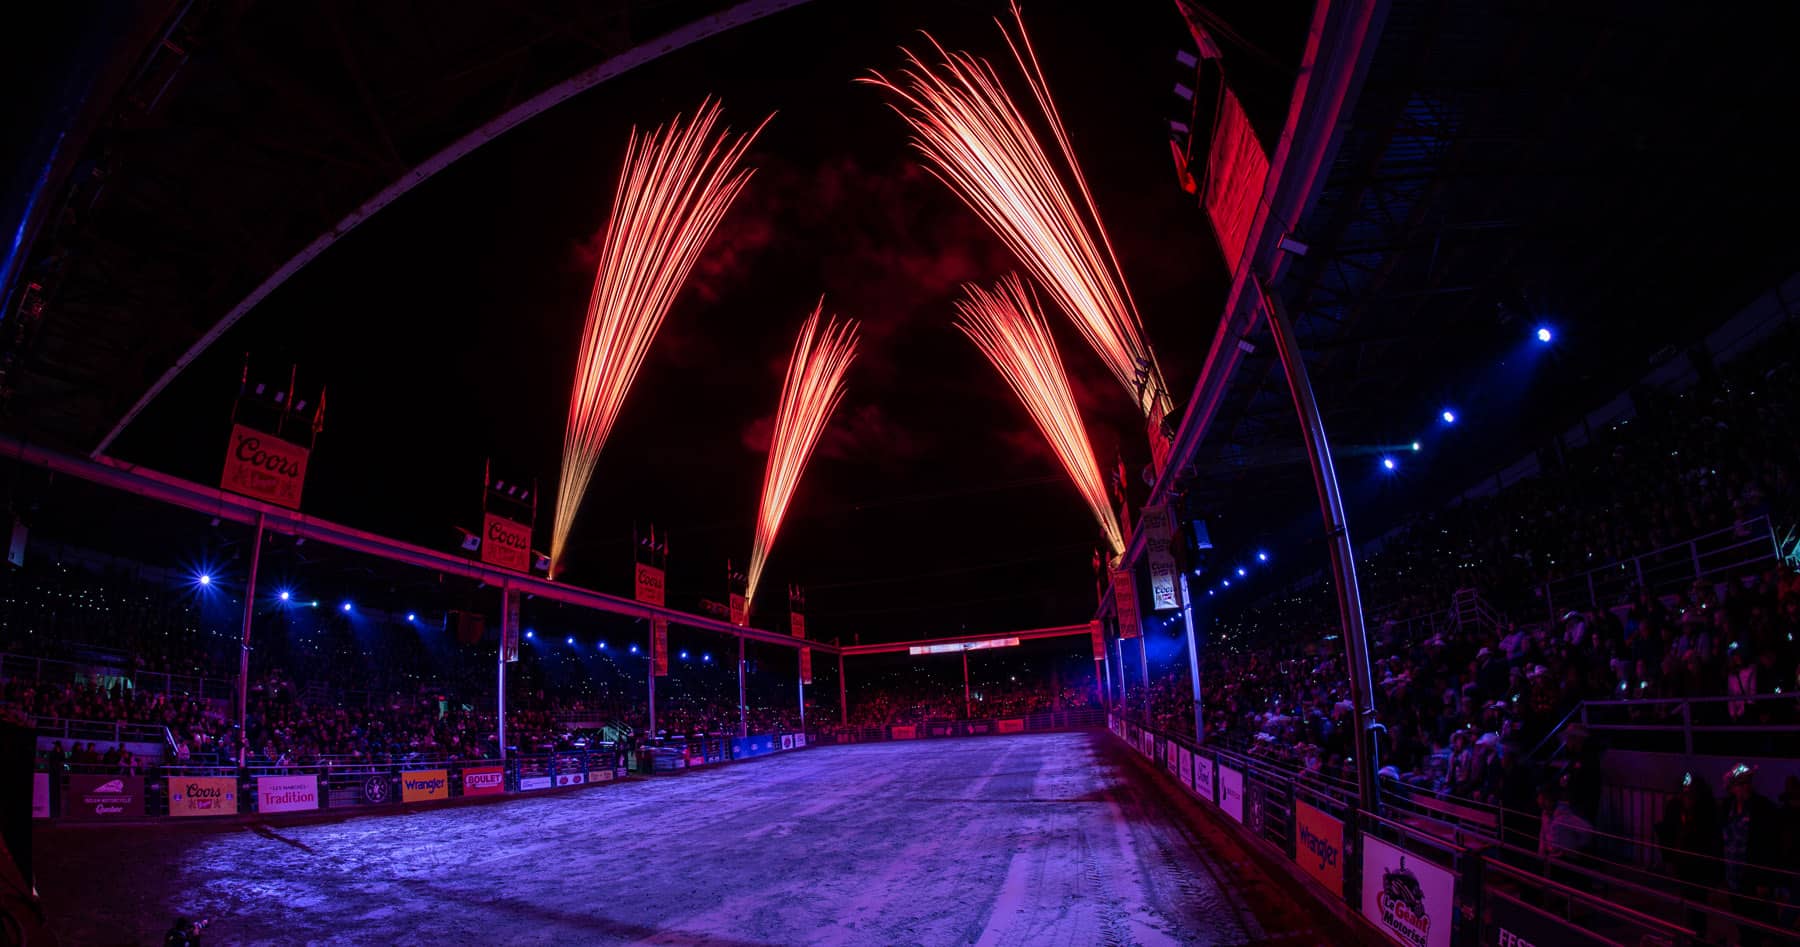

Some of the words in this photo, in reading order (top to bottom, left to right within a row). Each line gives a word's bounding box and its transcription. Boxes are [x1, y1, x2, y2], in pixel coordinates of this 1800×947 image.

[236, 435, 299, 478] Coors
[488, 521, 527, 549] Coors
[405, 777, 445, 794] Wrangler
[468, 774, 501, 784] BOULET
[186, 783, 221, 798] Coors
[264, 791, 314, 805] Tradition
[1298, 822, 1338, 870] Wrangler
[1384, 896, 1395, 911] Le
